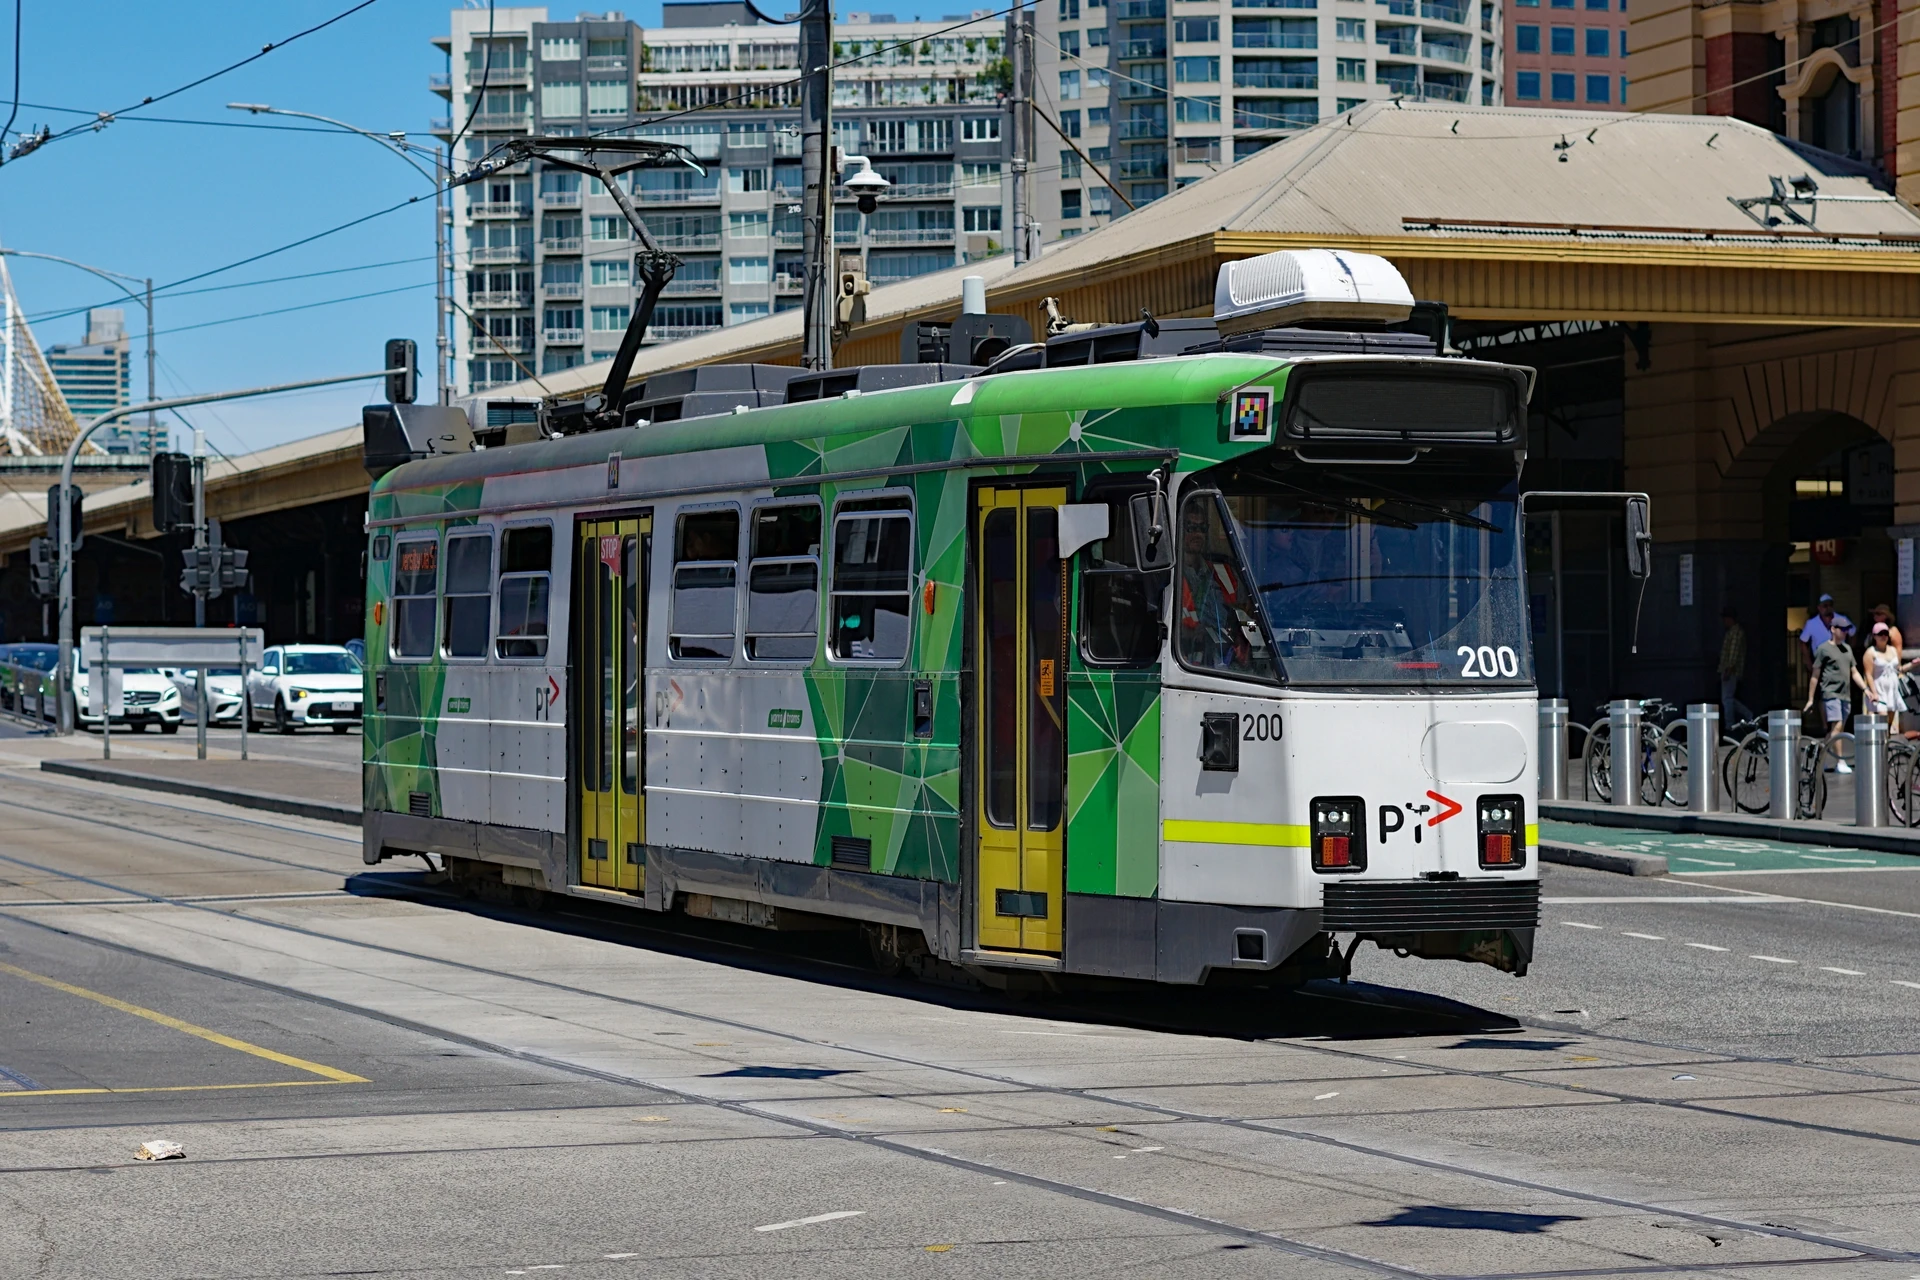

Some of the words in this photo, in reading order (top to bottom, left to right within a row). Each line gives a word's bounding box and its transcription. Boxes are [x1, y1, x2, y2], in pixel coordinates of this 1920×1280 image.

[788, 204, 801, 214] 216
[600, 538, 618, 560] STOP
[1456, 645, 1519, 679] 200
[1242, 713, 1283, 742] 200
